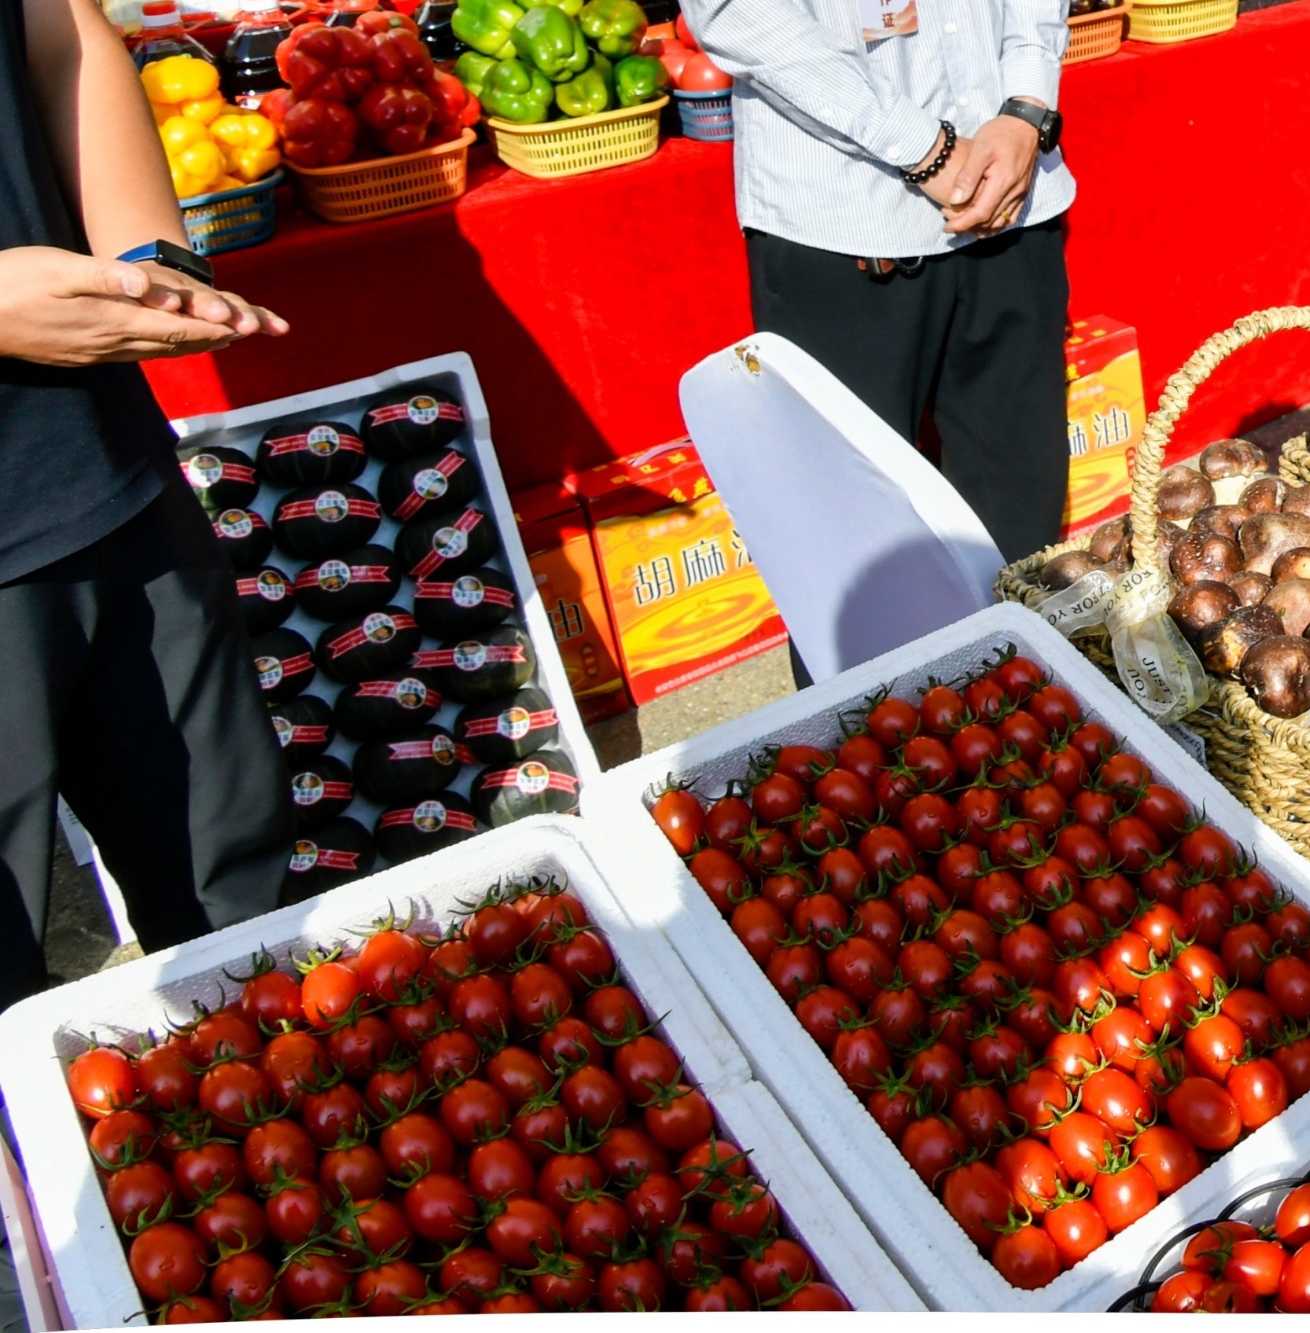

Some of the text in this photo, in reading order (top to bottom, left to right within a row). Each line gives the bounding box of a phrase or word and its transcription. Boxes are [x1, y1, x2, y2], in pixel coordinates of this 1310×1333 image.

[1122, 570, 1153, 593] FOR
[1047, 609, 1067, 626] YO
[1143, 657, 1173, 697] JUST
